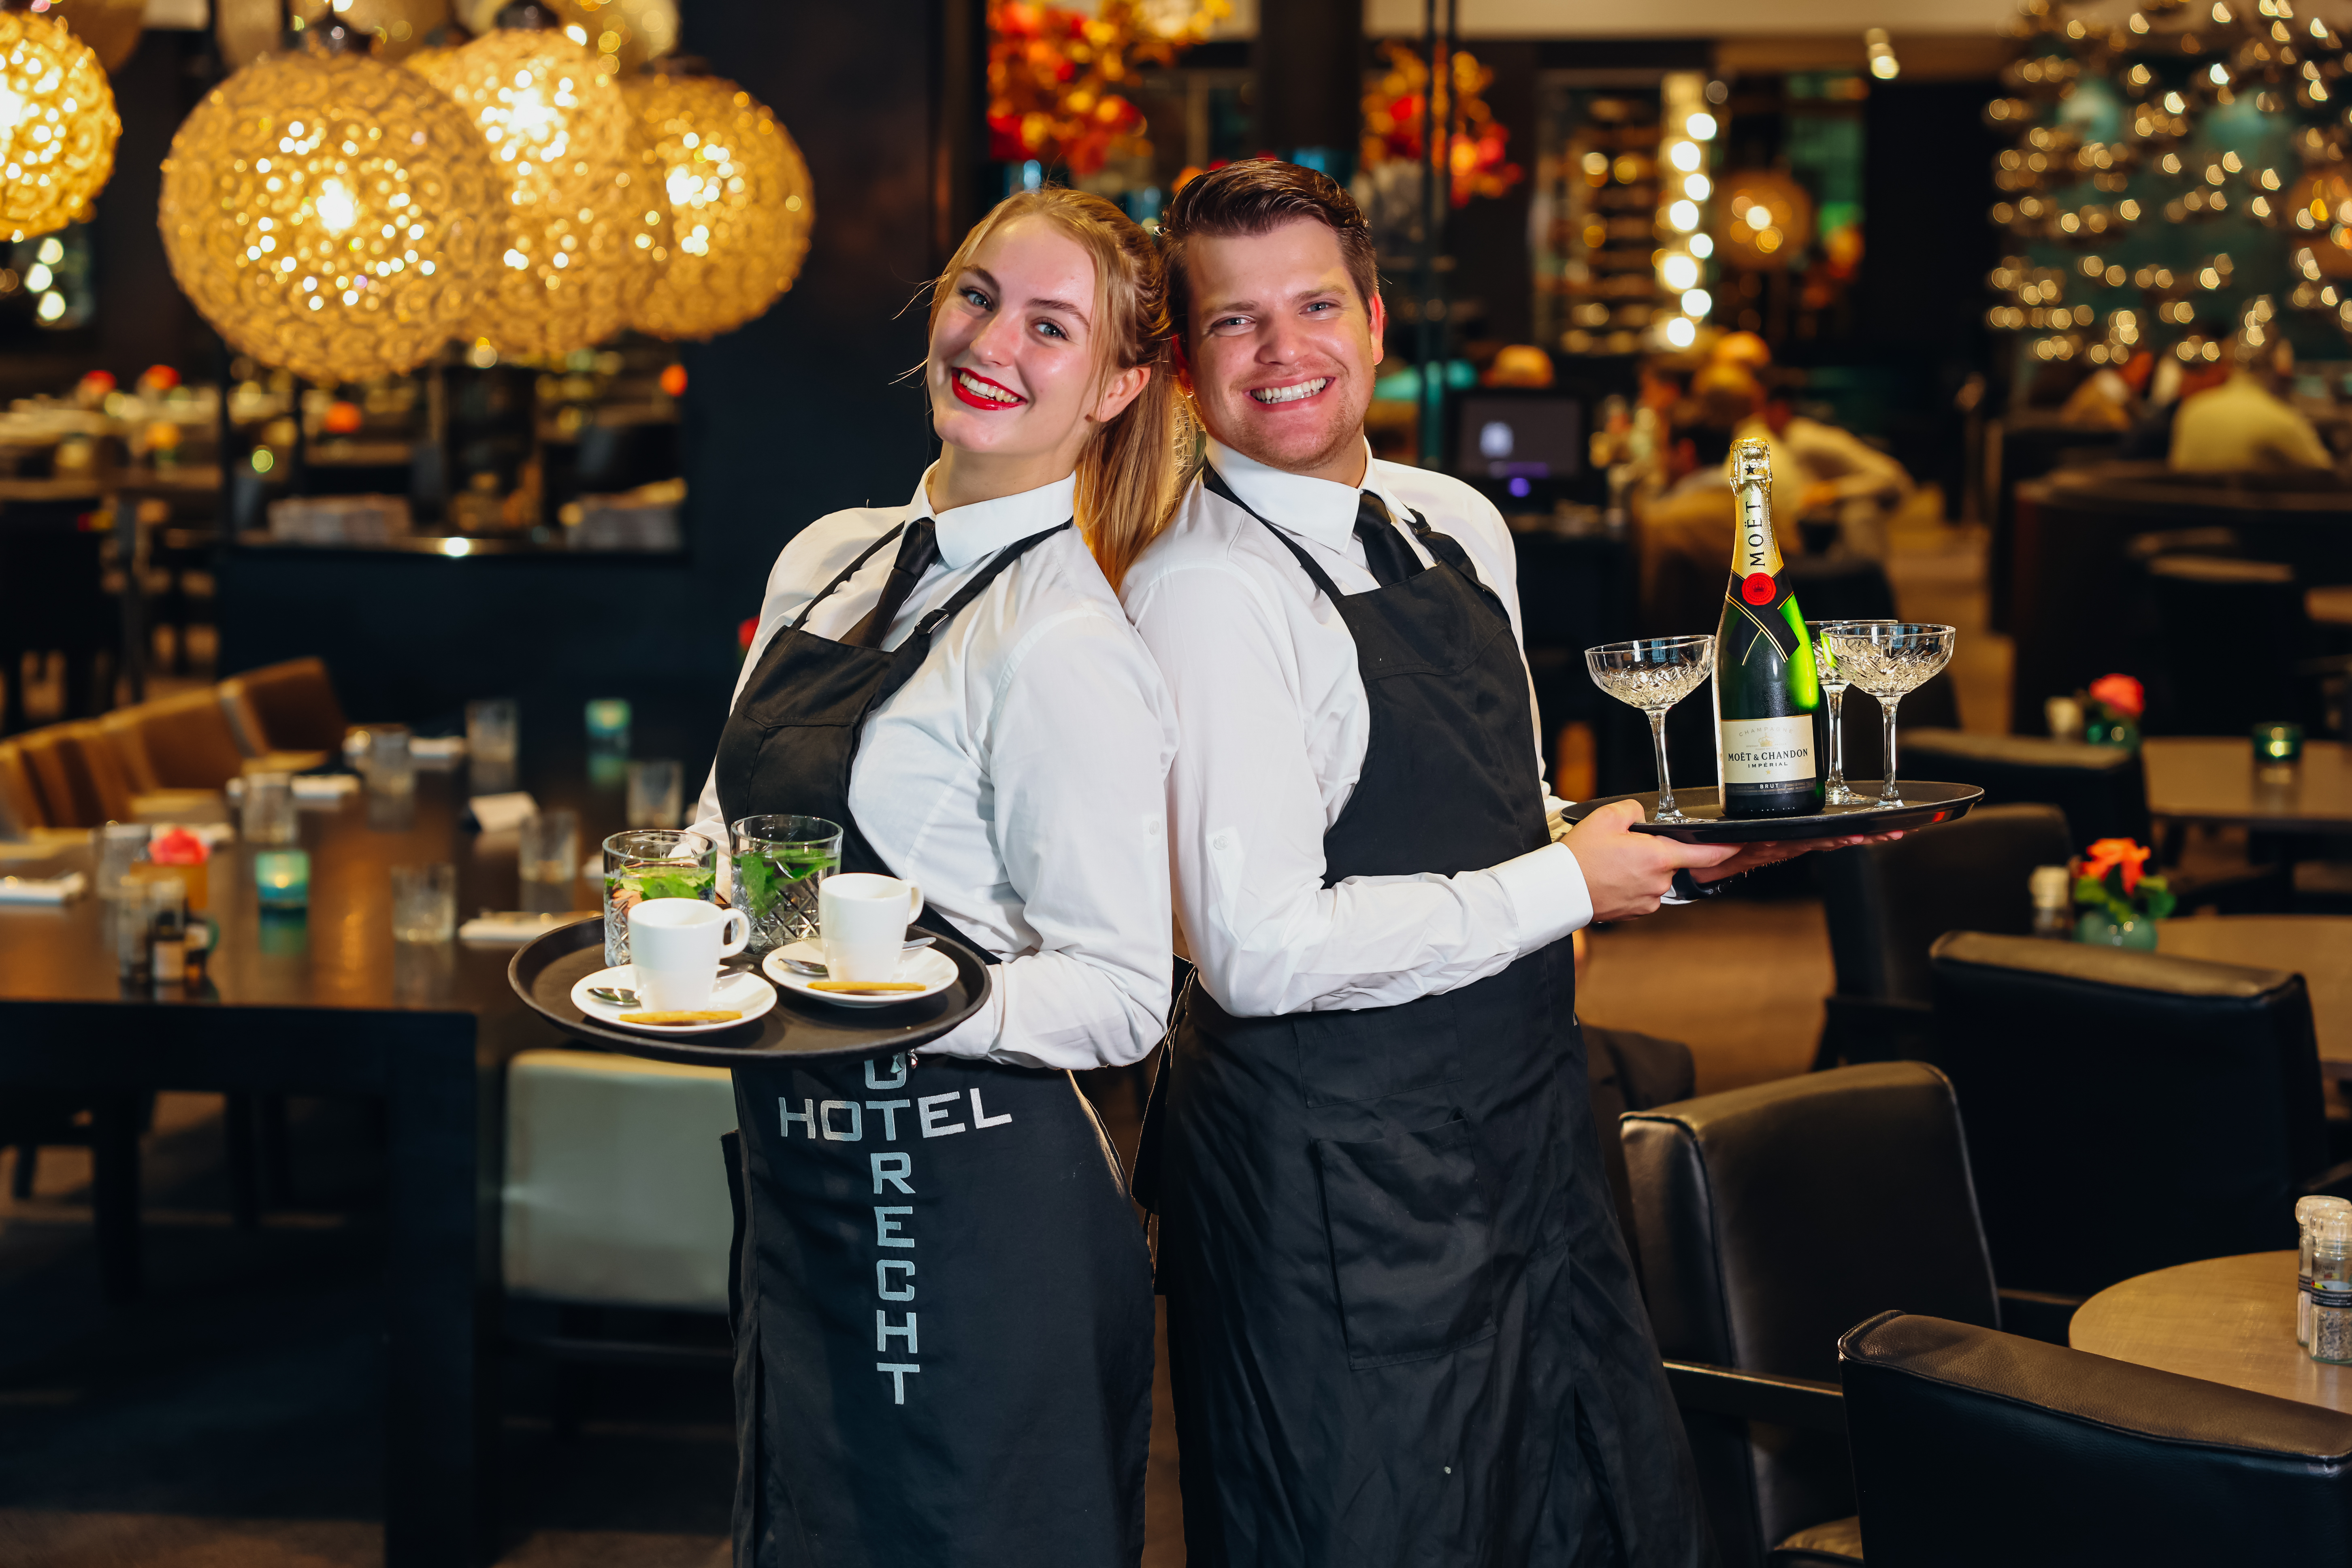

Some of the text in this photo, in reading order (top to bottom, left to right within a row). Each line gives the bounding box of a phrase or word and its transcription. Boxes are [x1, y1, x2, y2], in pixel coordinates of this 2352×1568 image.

[1745, 501, 1765, 567] MOËT
[1739, 727, 1793, 737] CHAMPAGNE
[1728, 752, 1751, 761] MOËT
[1761, 748, 1808, 760] CHANDON
[778, 1088, 1012, 1141] HOTEL
